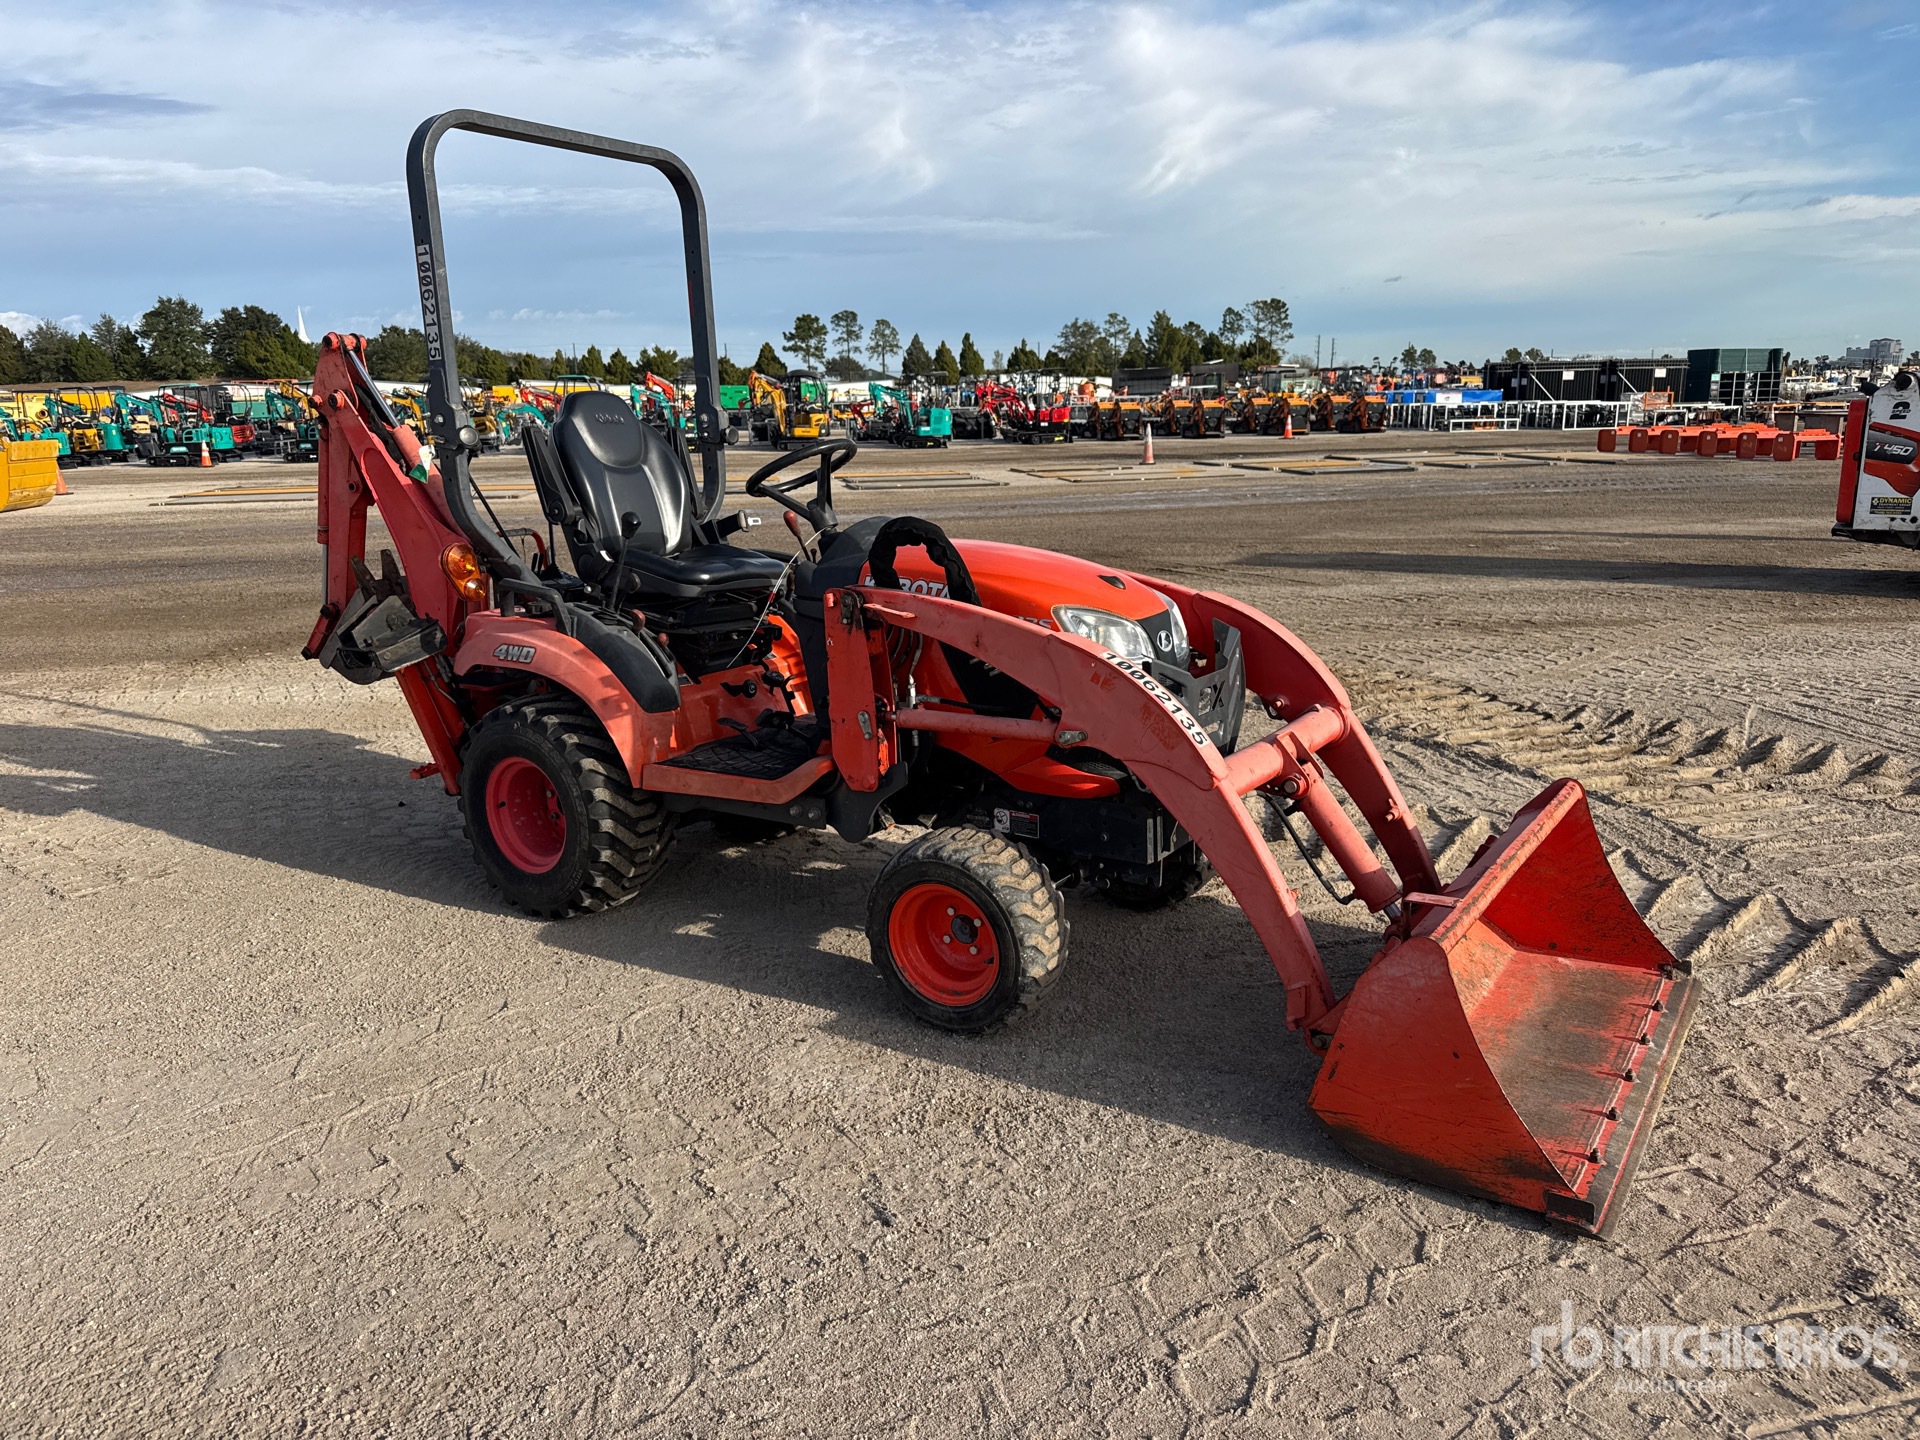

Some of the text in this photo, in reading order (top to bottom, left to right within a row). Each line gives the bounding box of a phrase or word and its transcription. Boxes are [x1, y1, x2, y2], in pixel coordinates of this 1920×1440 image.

[417, 246, 441, 359] 10062135
[1873, 442, 1914, 456] T450
[864, 576, 951, 600] KBOTA
[493, 643, 536, 664] 4WD
[1106, 652, 1208, 746] 10062135
